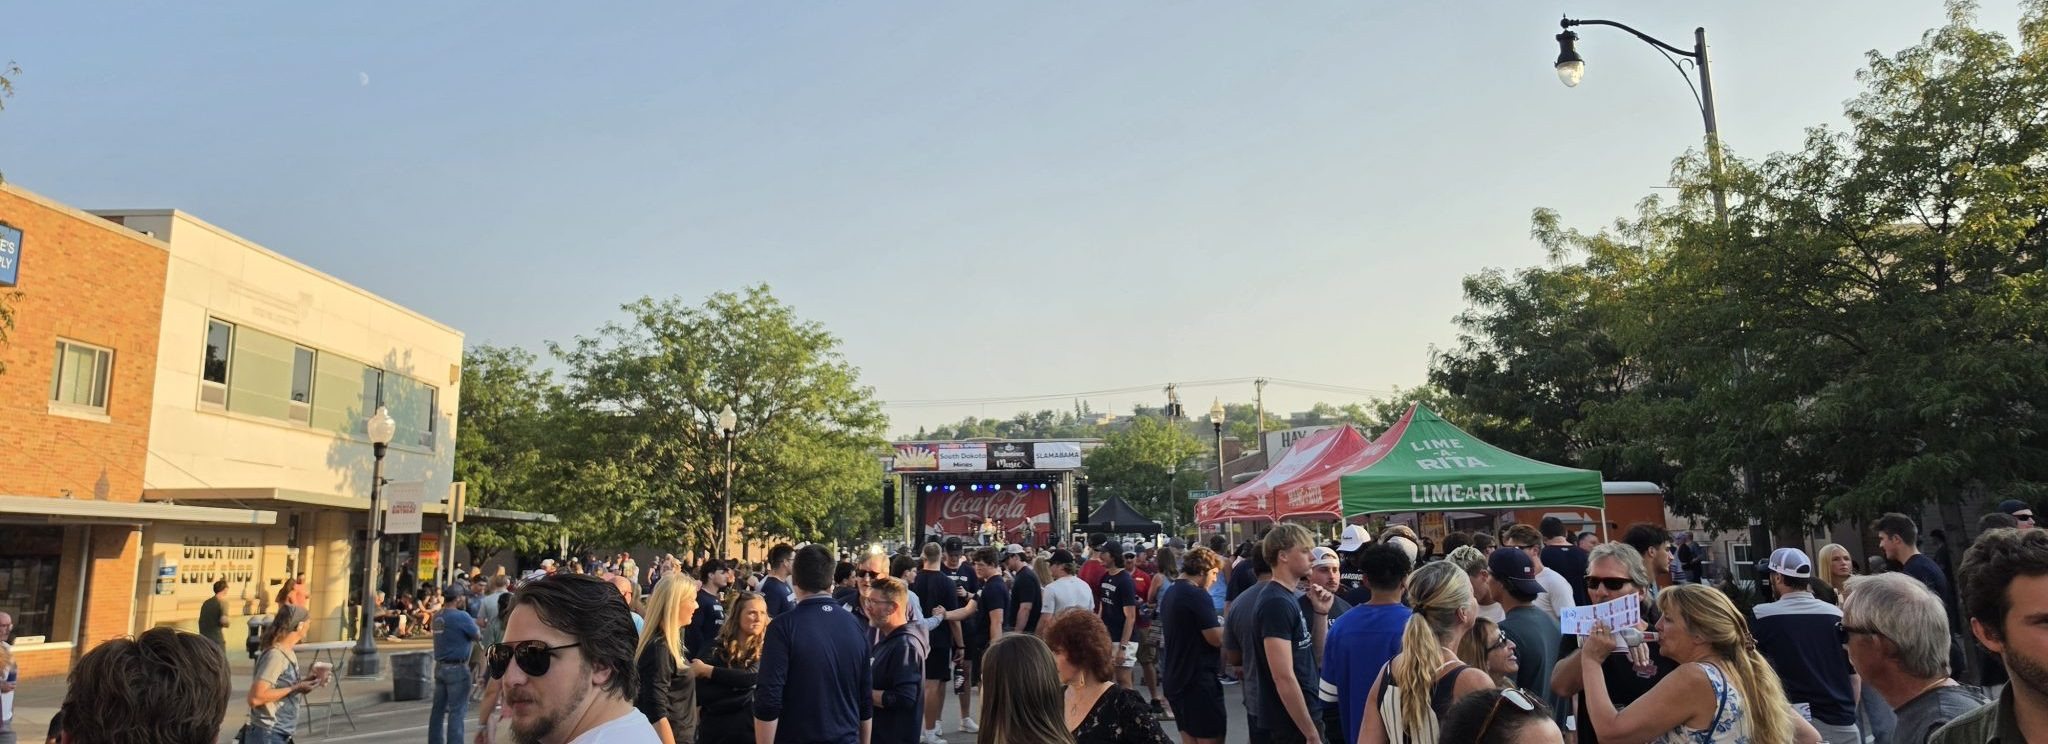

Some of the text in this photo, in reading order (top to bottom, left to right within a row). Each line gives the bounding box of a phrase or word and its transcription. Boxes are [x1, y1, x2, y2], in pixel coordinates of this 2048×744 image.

[1411, 438, 1464, 452] LIME
[940, 452, 987, 460] South Dakota
[1416, 456, 1489, 470] RITA
[996, 459, 1022, 469] Music
[183, 536, 255, 559] black hills
[181, 561, 254, 584] card shop
